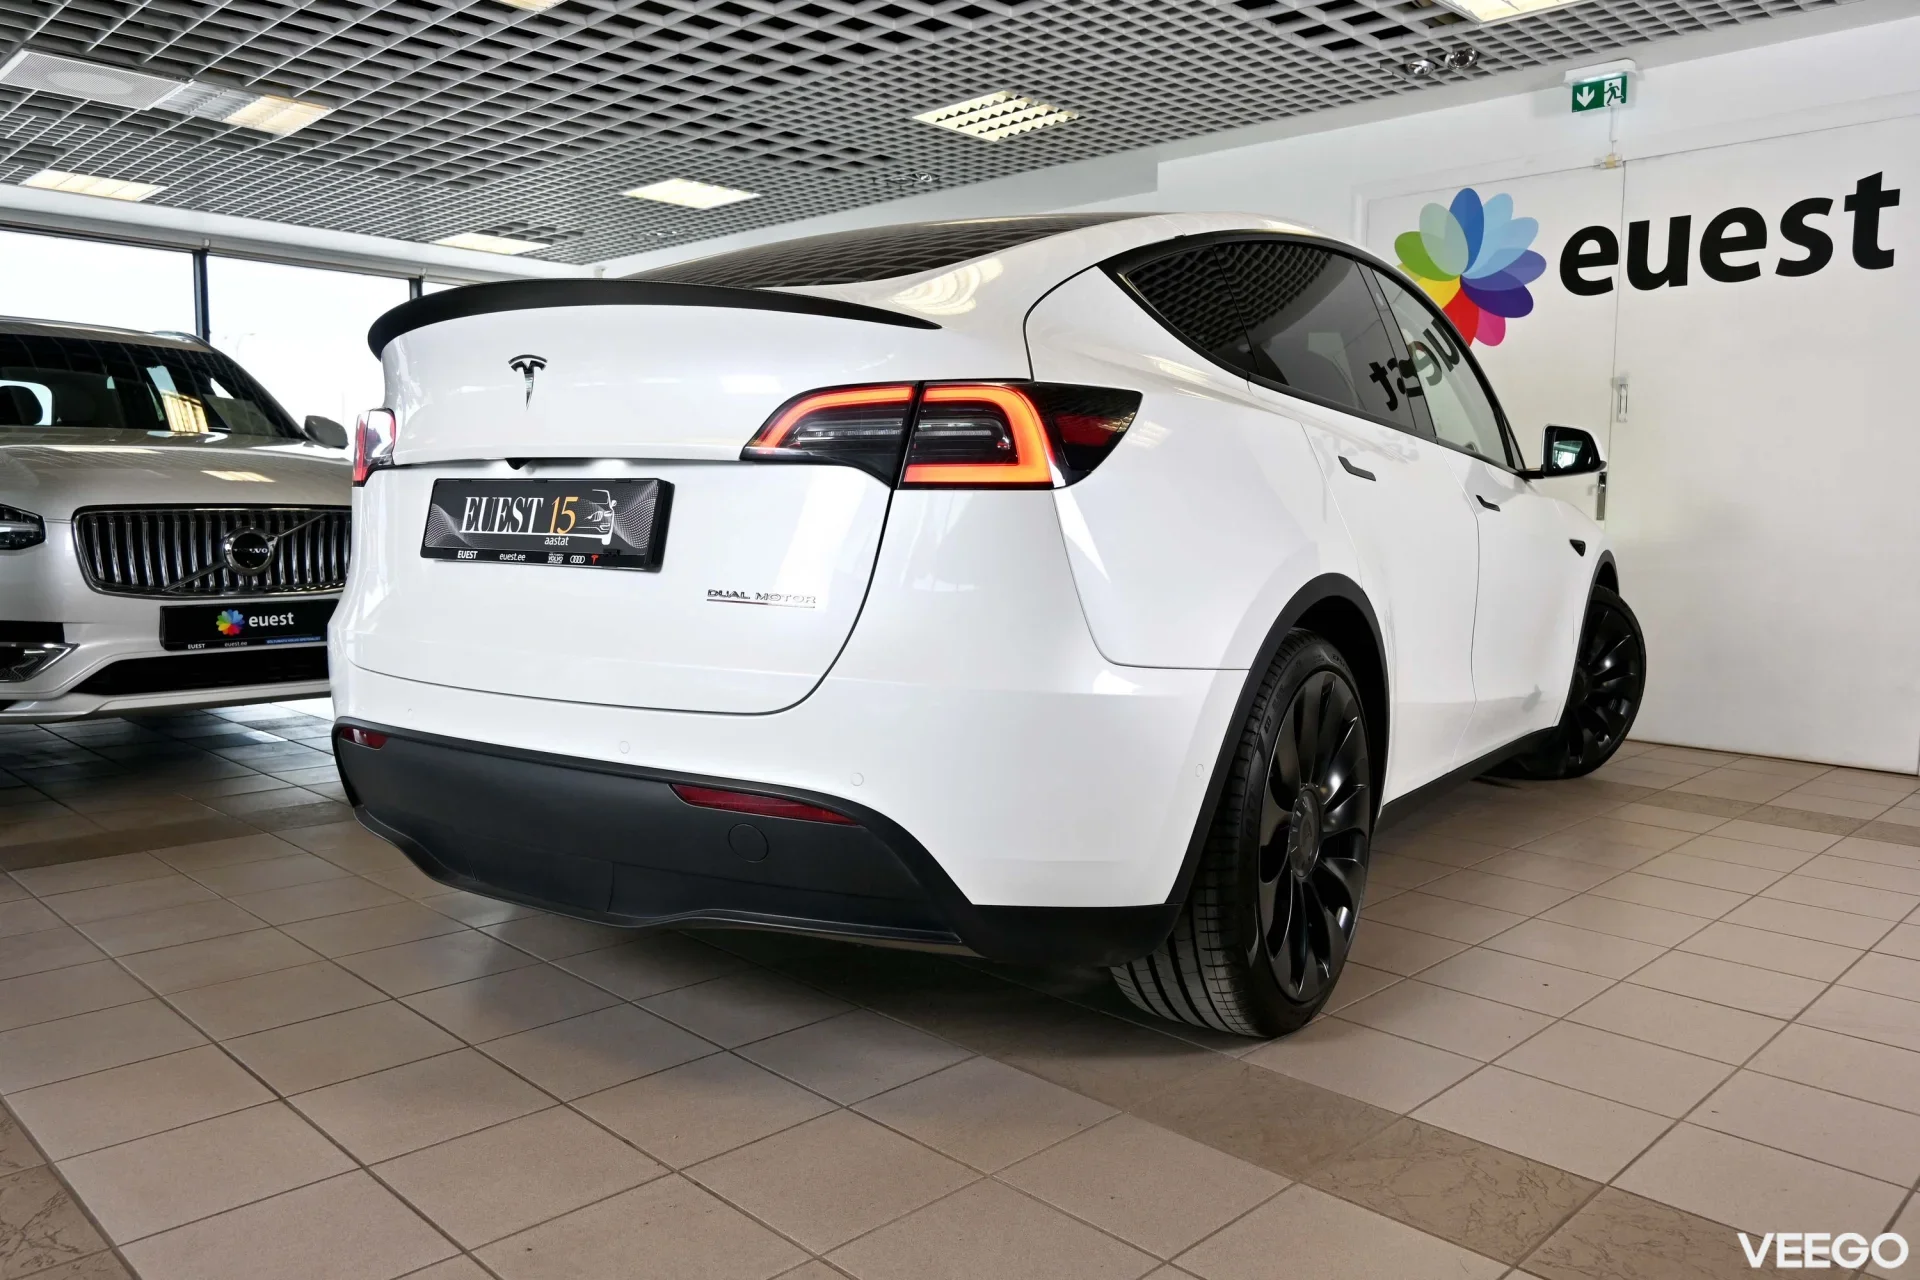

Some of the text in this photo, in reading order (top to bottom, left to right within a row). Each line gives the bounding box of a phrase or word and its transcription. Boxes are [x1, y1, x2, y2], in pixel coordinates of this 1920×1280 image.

[1559, 171, 1901, 296] euest
[459, 496, 579, 535] EUEST 15
[544, 536, 569, 546] aastat
[457, 550, 478, 559] EUEST
[499, 552, 526, 561] euest.ee
[707, 588, 817, 604] DUAL MOTOR
[248, 612, 295, 627] euest
[224, 640, 248, 648] euest.ee
